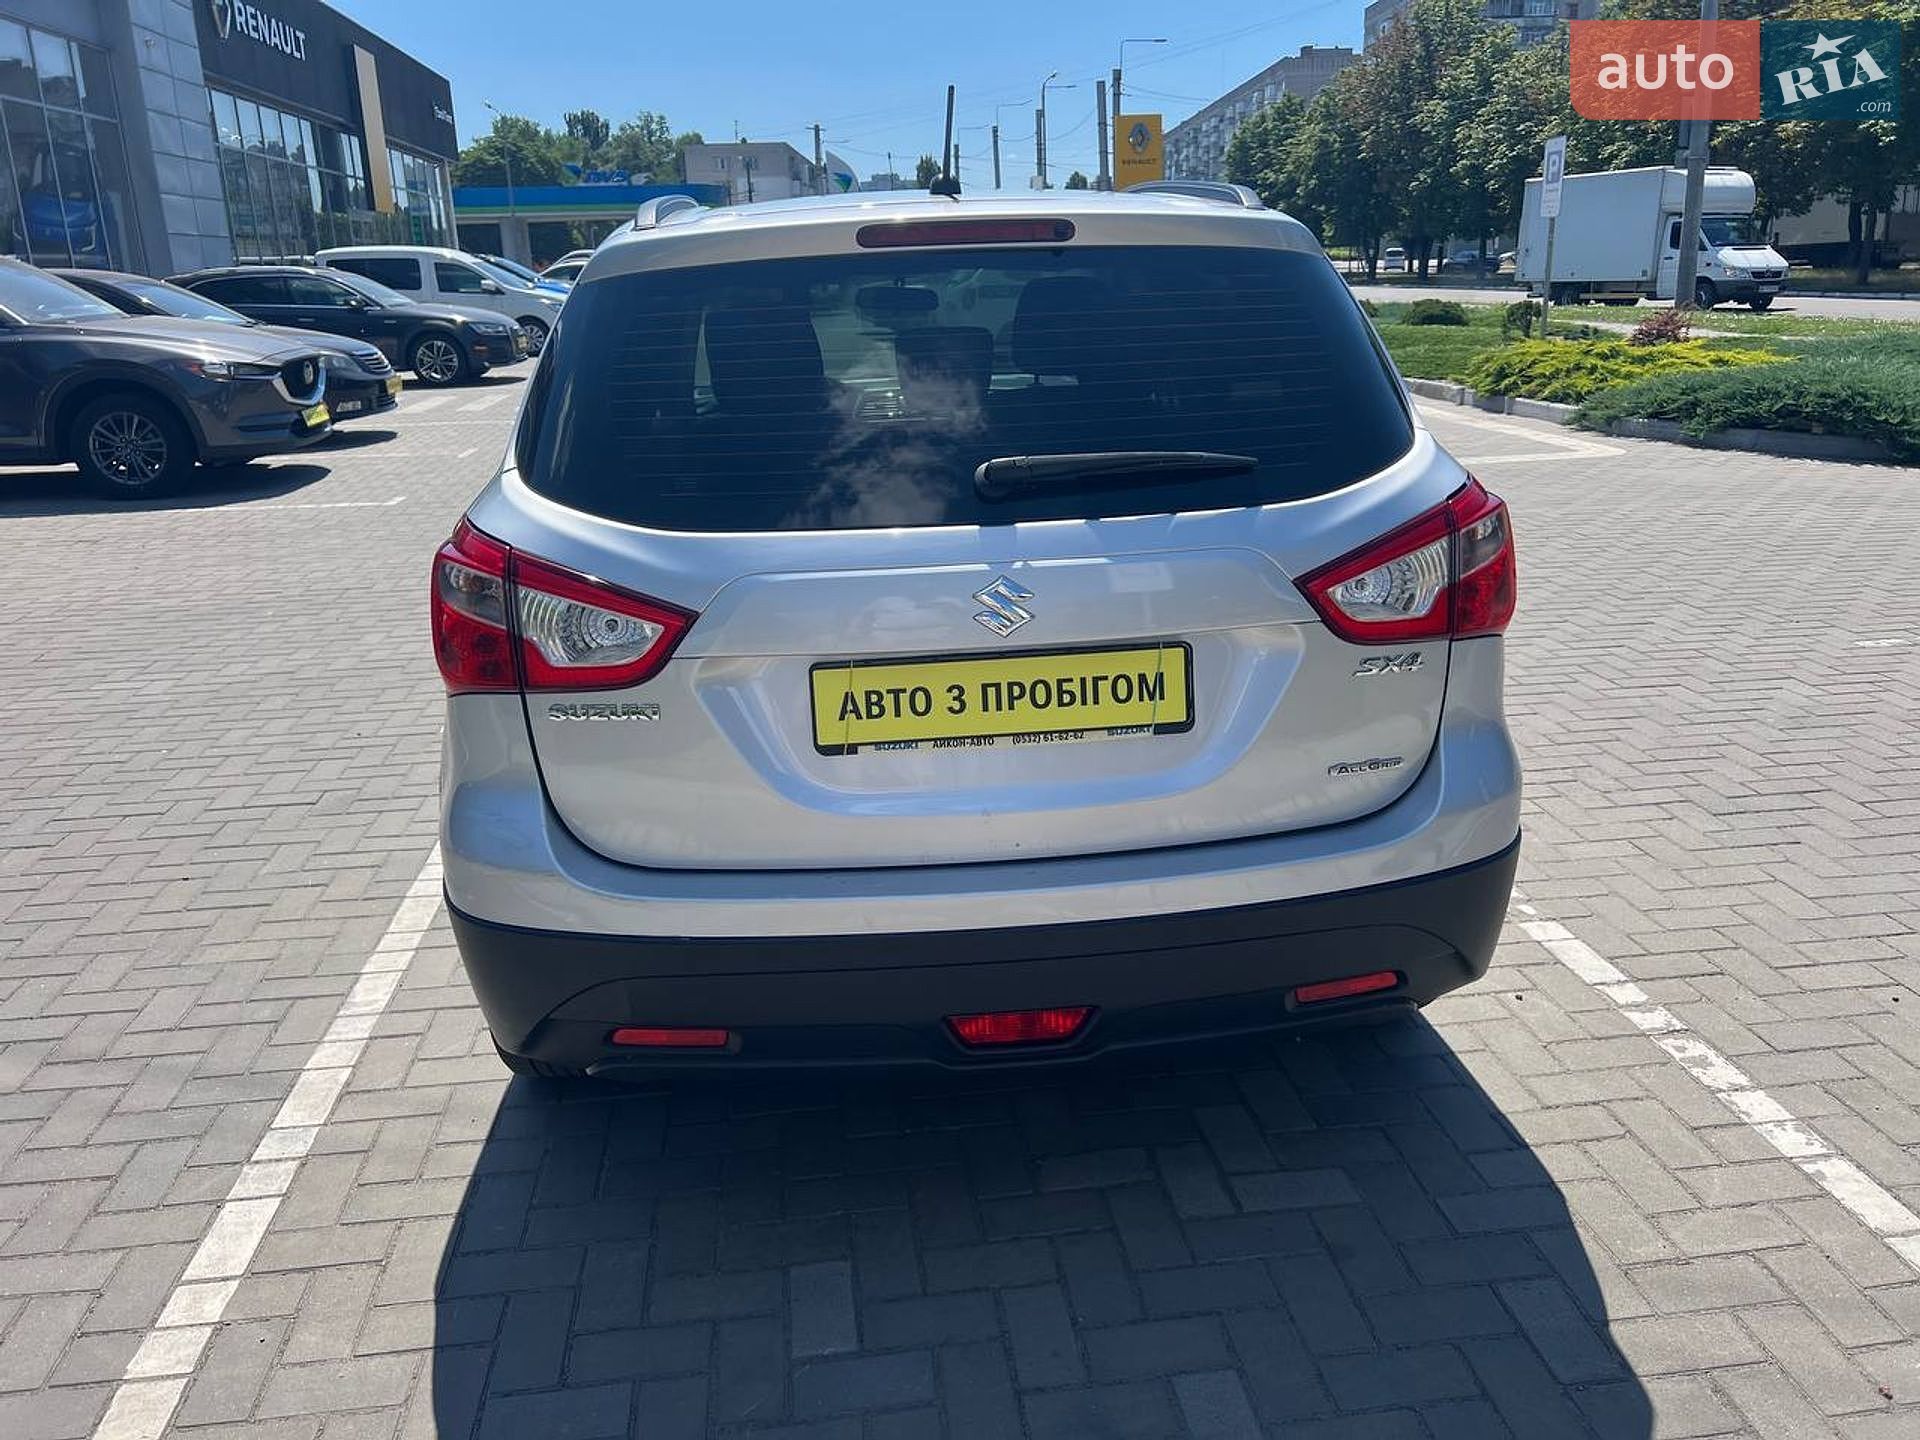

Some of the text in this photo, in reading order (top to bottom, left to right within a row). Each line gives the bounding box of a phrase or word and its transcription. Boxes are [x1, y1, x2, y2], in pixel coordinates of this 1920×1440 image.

[232, 0, 306, 61] RENAULT
[1351, 652, 1425, 677] SX4
[548, 703, 661, 721] SUZUKI
[837, 685, 932, 721] АВТО
[980, 671, 1166, 713] ПРОБІГОМ
